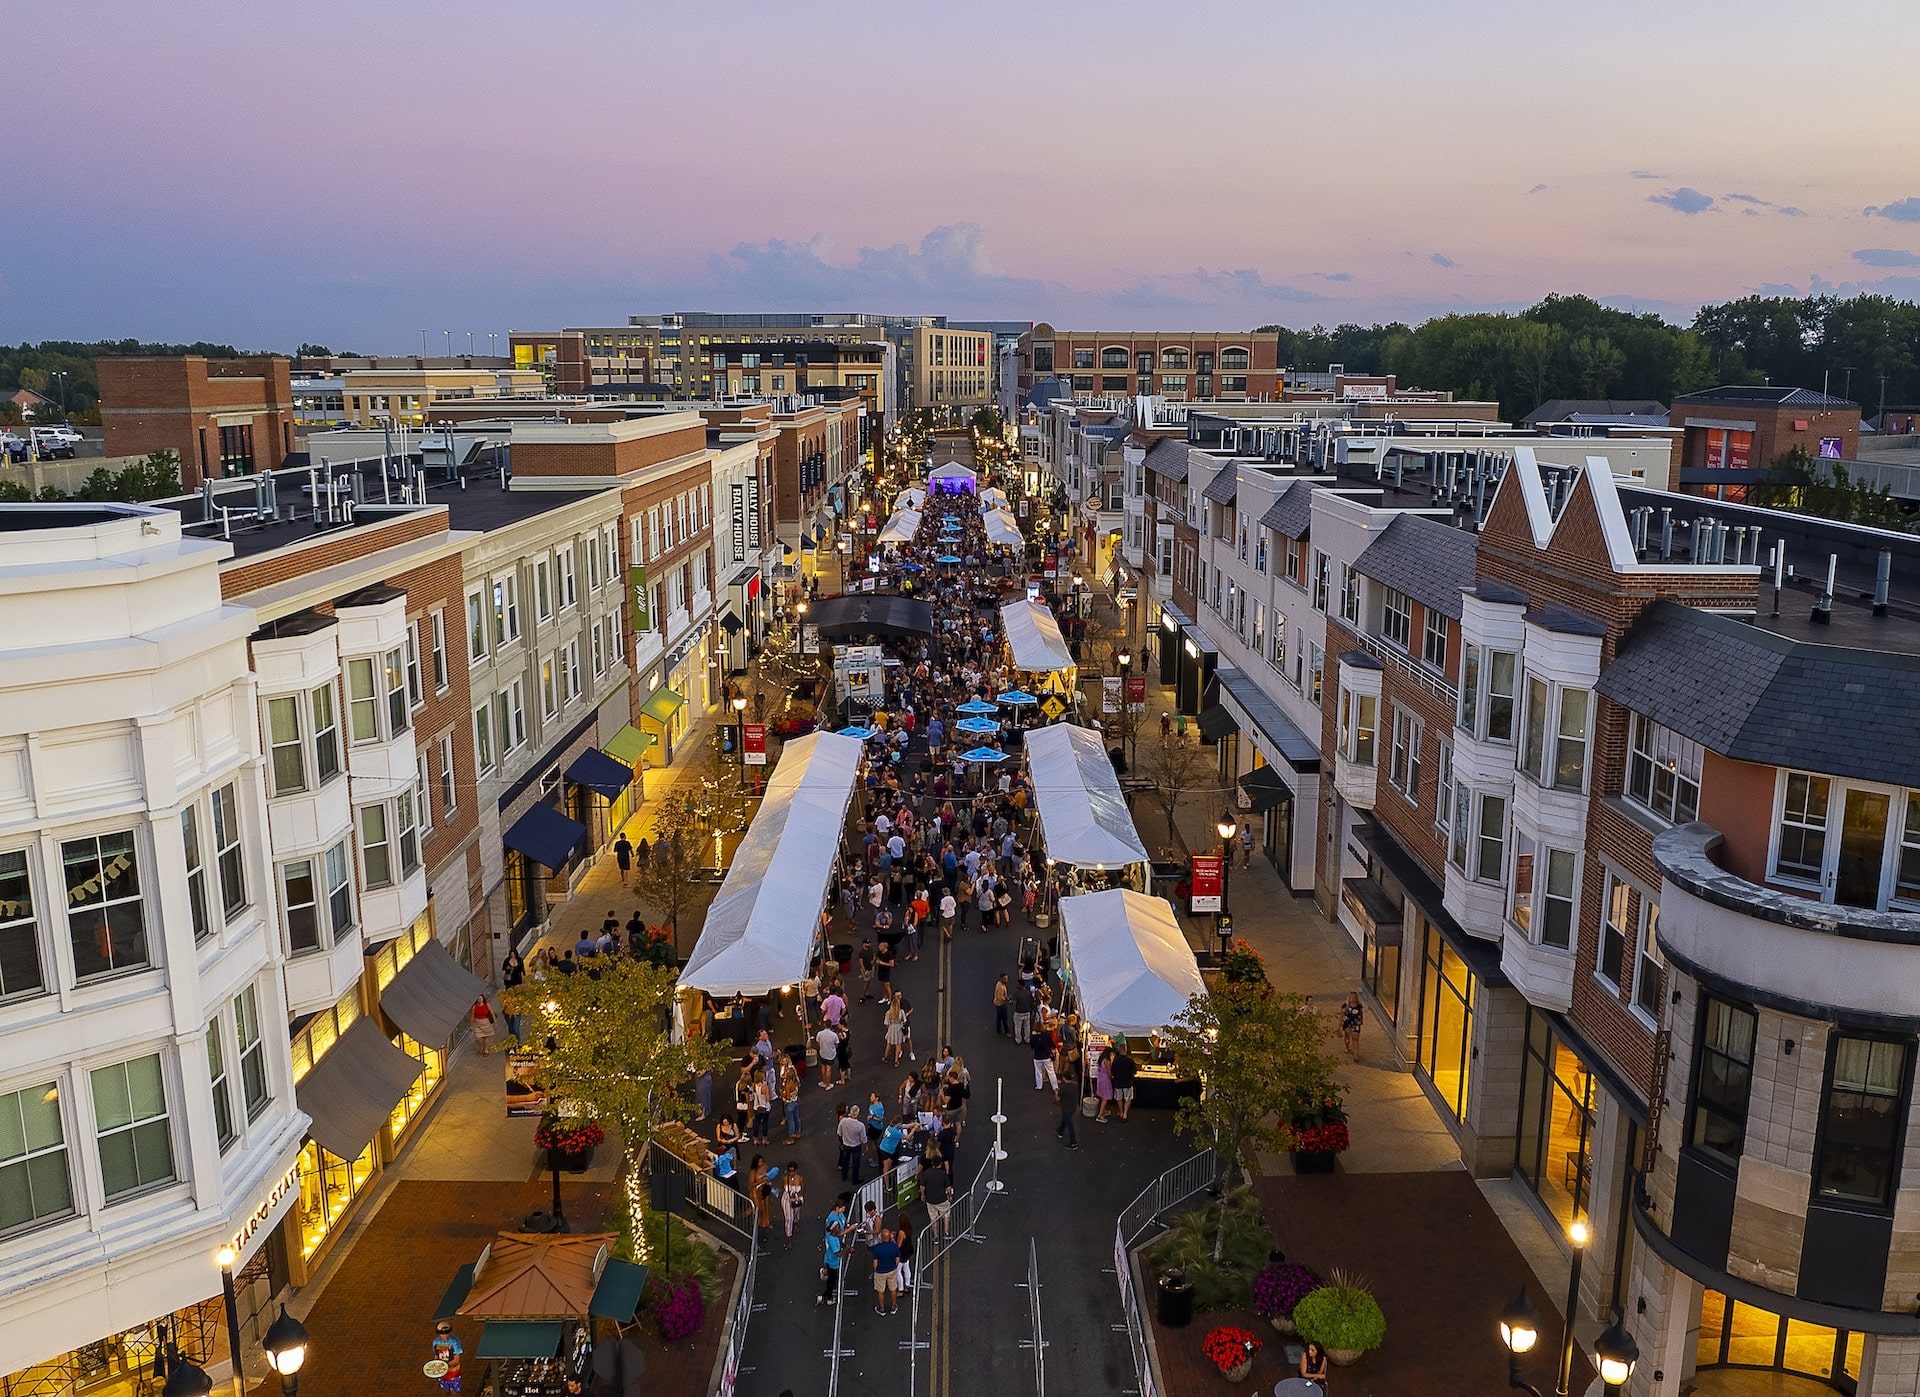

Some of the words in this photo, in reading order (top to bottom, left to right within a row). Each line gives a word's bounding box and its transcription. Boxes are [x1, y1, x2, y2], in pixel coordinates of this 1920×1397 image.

[732, 488, 743, 520] RALLY
[749, 479, 758, 510] RALLY
[733, 523, 744, 560] HOUSE
[750, 512, 759, 546] HOUSE
[269, 1159, 300, 1209] STATE
